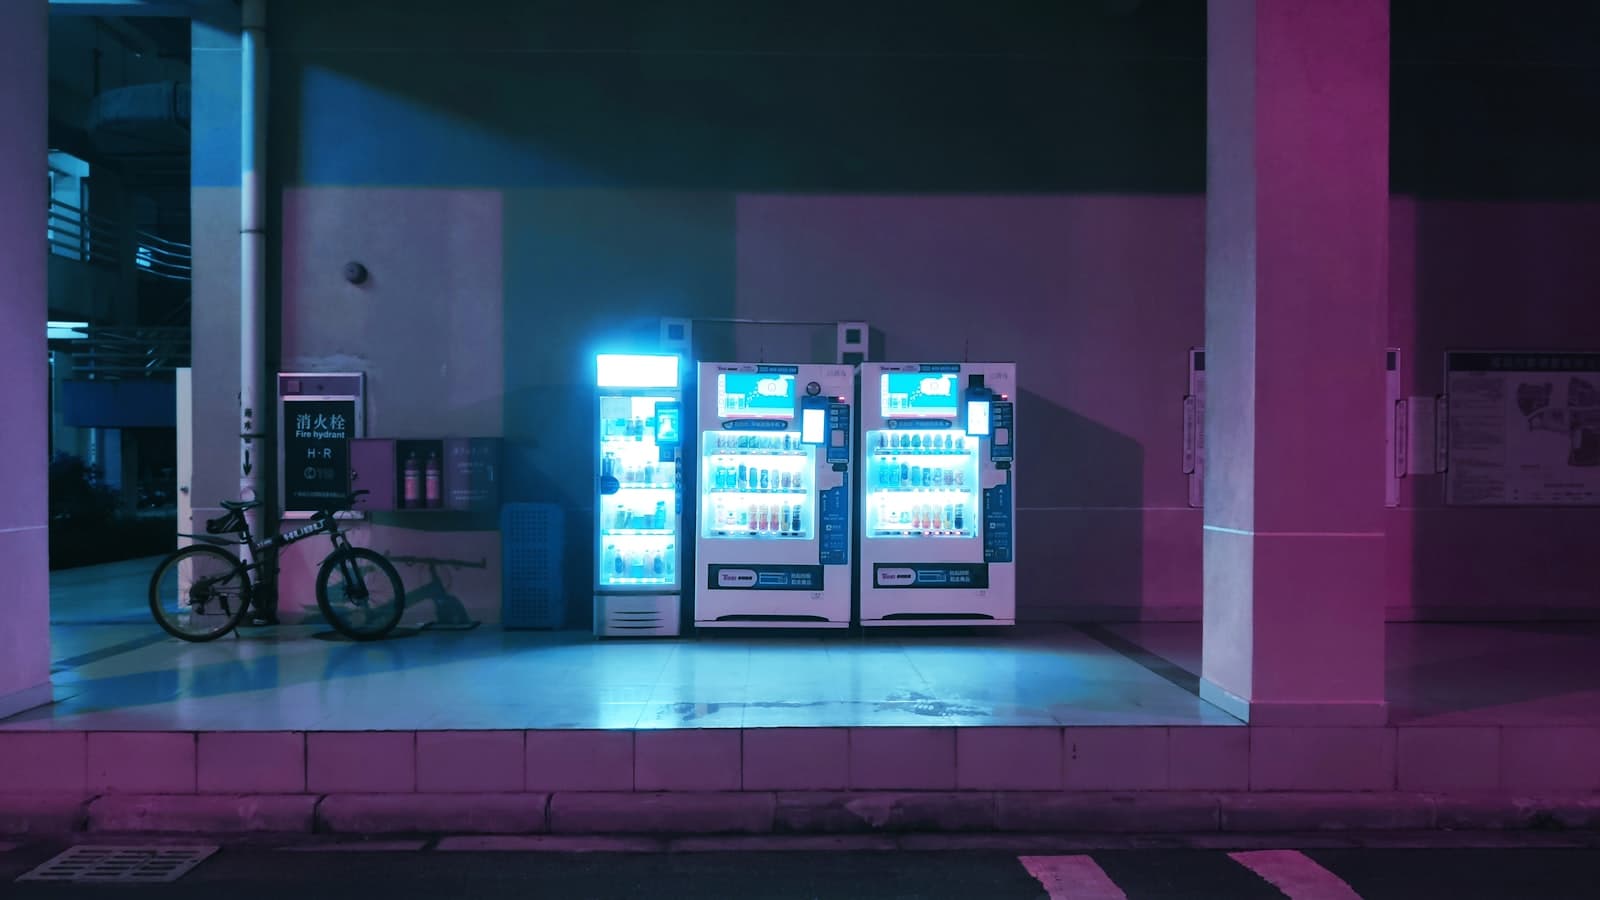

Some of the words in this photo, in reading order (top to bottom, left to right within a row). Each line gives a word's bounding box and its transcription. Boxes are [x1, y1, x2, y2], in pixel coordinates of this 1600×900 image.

[296, 413, 345, 430] 消火栓
[296, 430, 312, 438] Fire
[313, 430, 345, 440] hydrant
